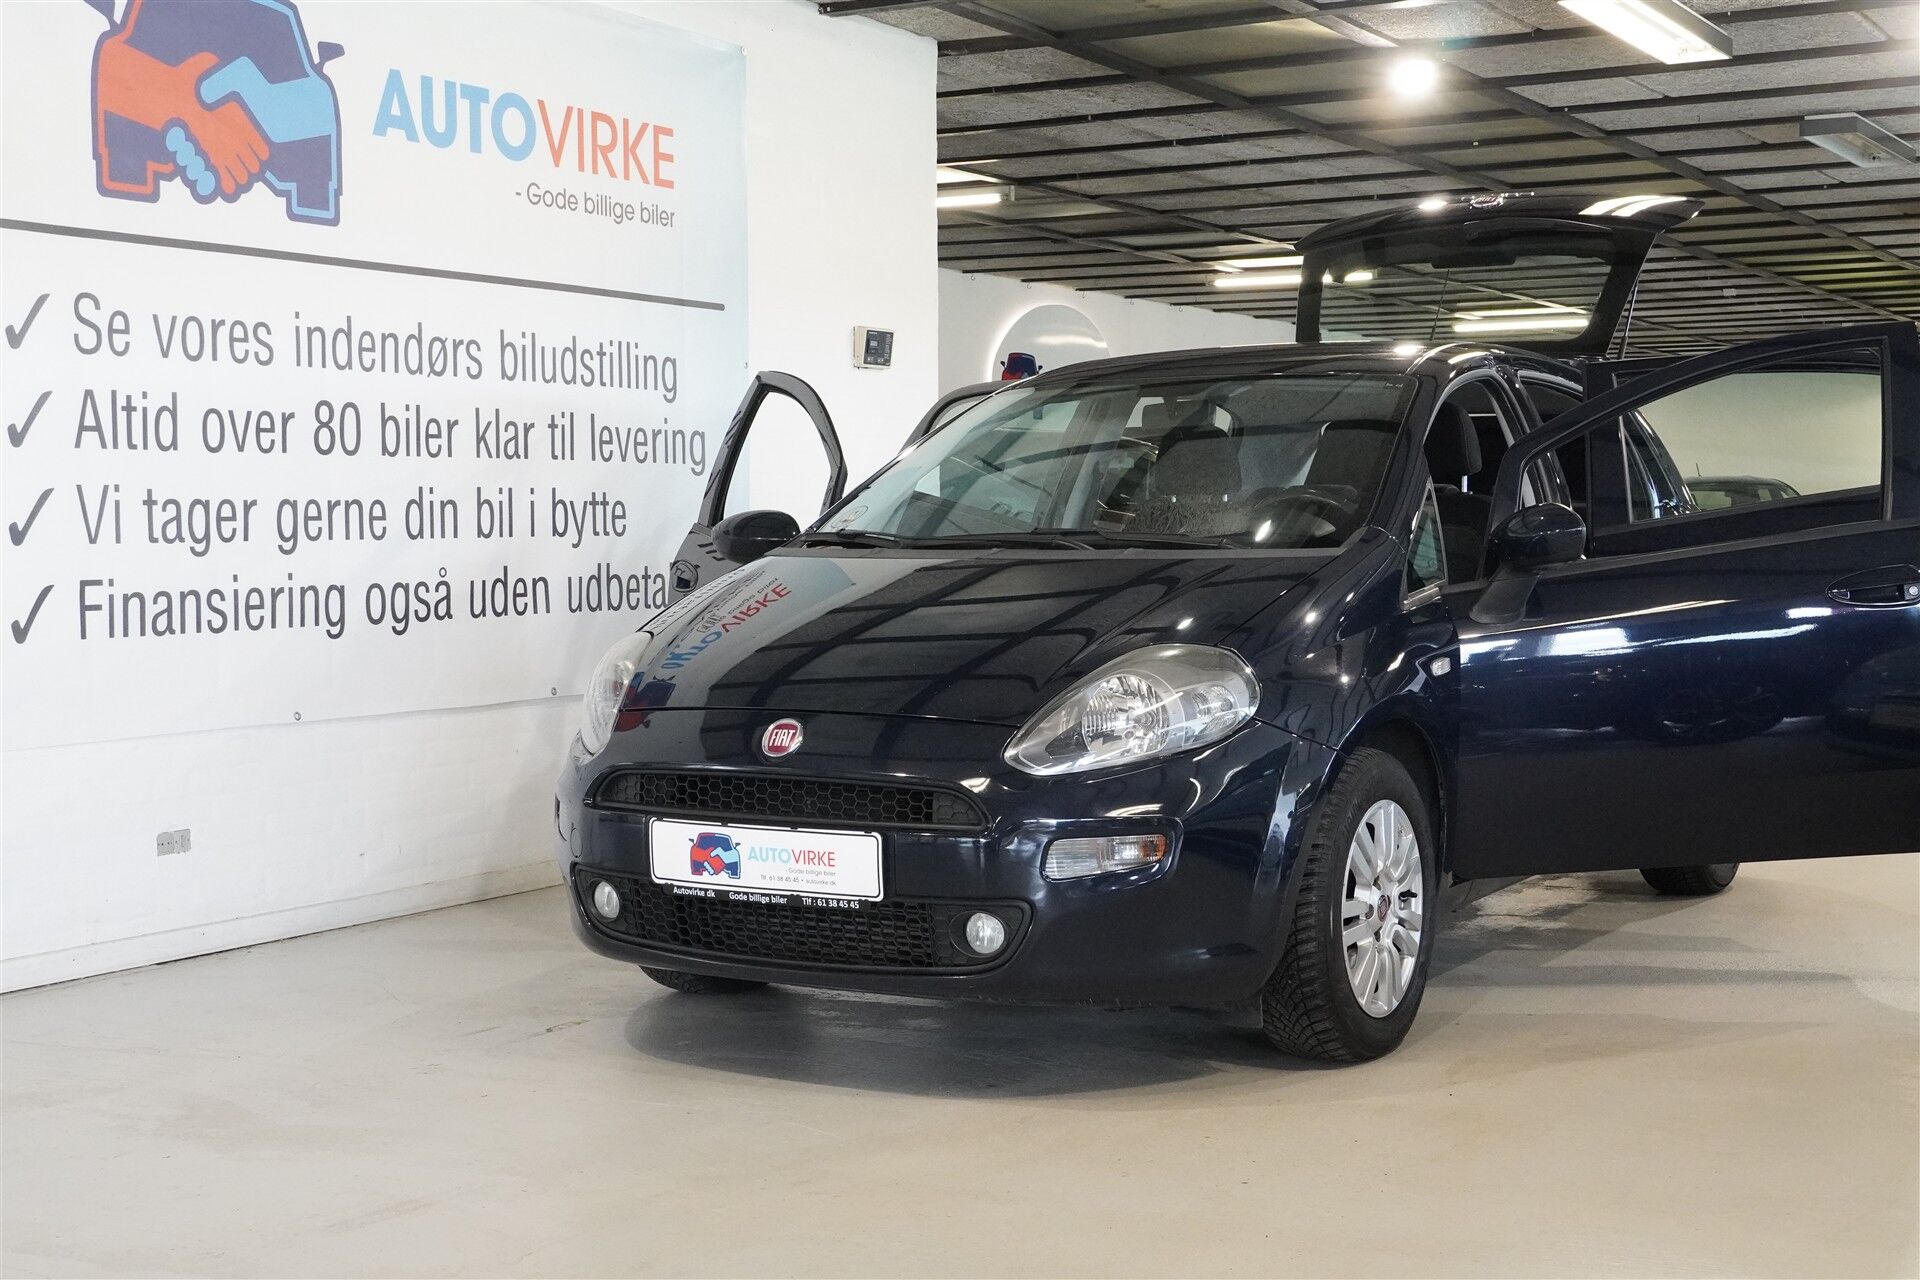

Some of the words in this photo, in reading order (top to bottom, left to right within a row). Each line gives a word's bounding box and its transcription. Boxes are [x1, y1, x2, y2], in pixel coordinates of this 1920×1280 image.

[372, 68, 674, 189] AUTOVIRKE
[527, 182, 579, 211] Gode
[584, 192, 635, 225] billige
[640, 202, 675, 227] biler
[74, 292, 131, 357] Se
[152, 313, 274, 367] vores
[294, 312, 483, 380] indendørs
[500, 328, 678, 404] biludstilling
[74, 388, 179, 453] Altid
[202, 408, 296, 455] over
[313, 400, 362, 457] 80
[380, 402, 460, 459] biler
[475, 407, 536, 461] klar
[547, 411, 575, 462] til
[590, 412, 706, 477] levering
[75, 484, 122, 545] Vi
[142, 488, 258, 558] tager
[276, 498, 387, 556] gerne
[404, 485, 459, 541] din
[476, 486, 514, 540] bil
[529, 486, 536, 538] i
[551, 486, 627, 549] bytte
[79, 572, 346, 640] Finansiering
[365, 566, 454, 637] også
[469, 564, 551, 620] uden
[567, 562, 672, 617] udbeta
[769, 729, 796, 747] FIAT
[748, 846, 835, 867] AUTOVIRKE
[728, 891, 748, 901] Gode
[748, 892, 770, 904] billige
[771, 895, 788, 904] biler
[817, 898, 827, 907] 61
[828, 899, 838, 908] 38
[839, 900, 848, 908] 45
[849, 901, 860, 909] 45
